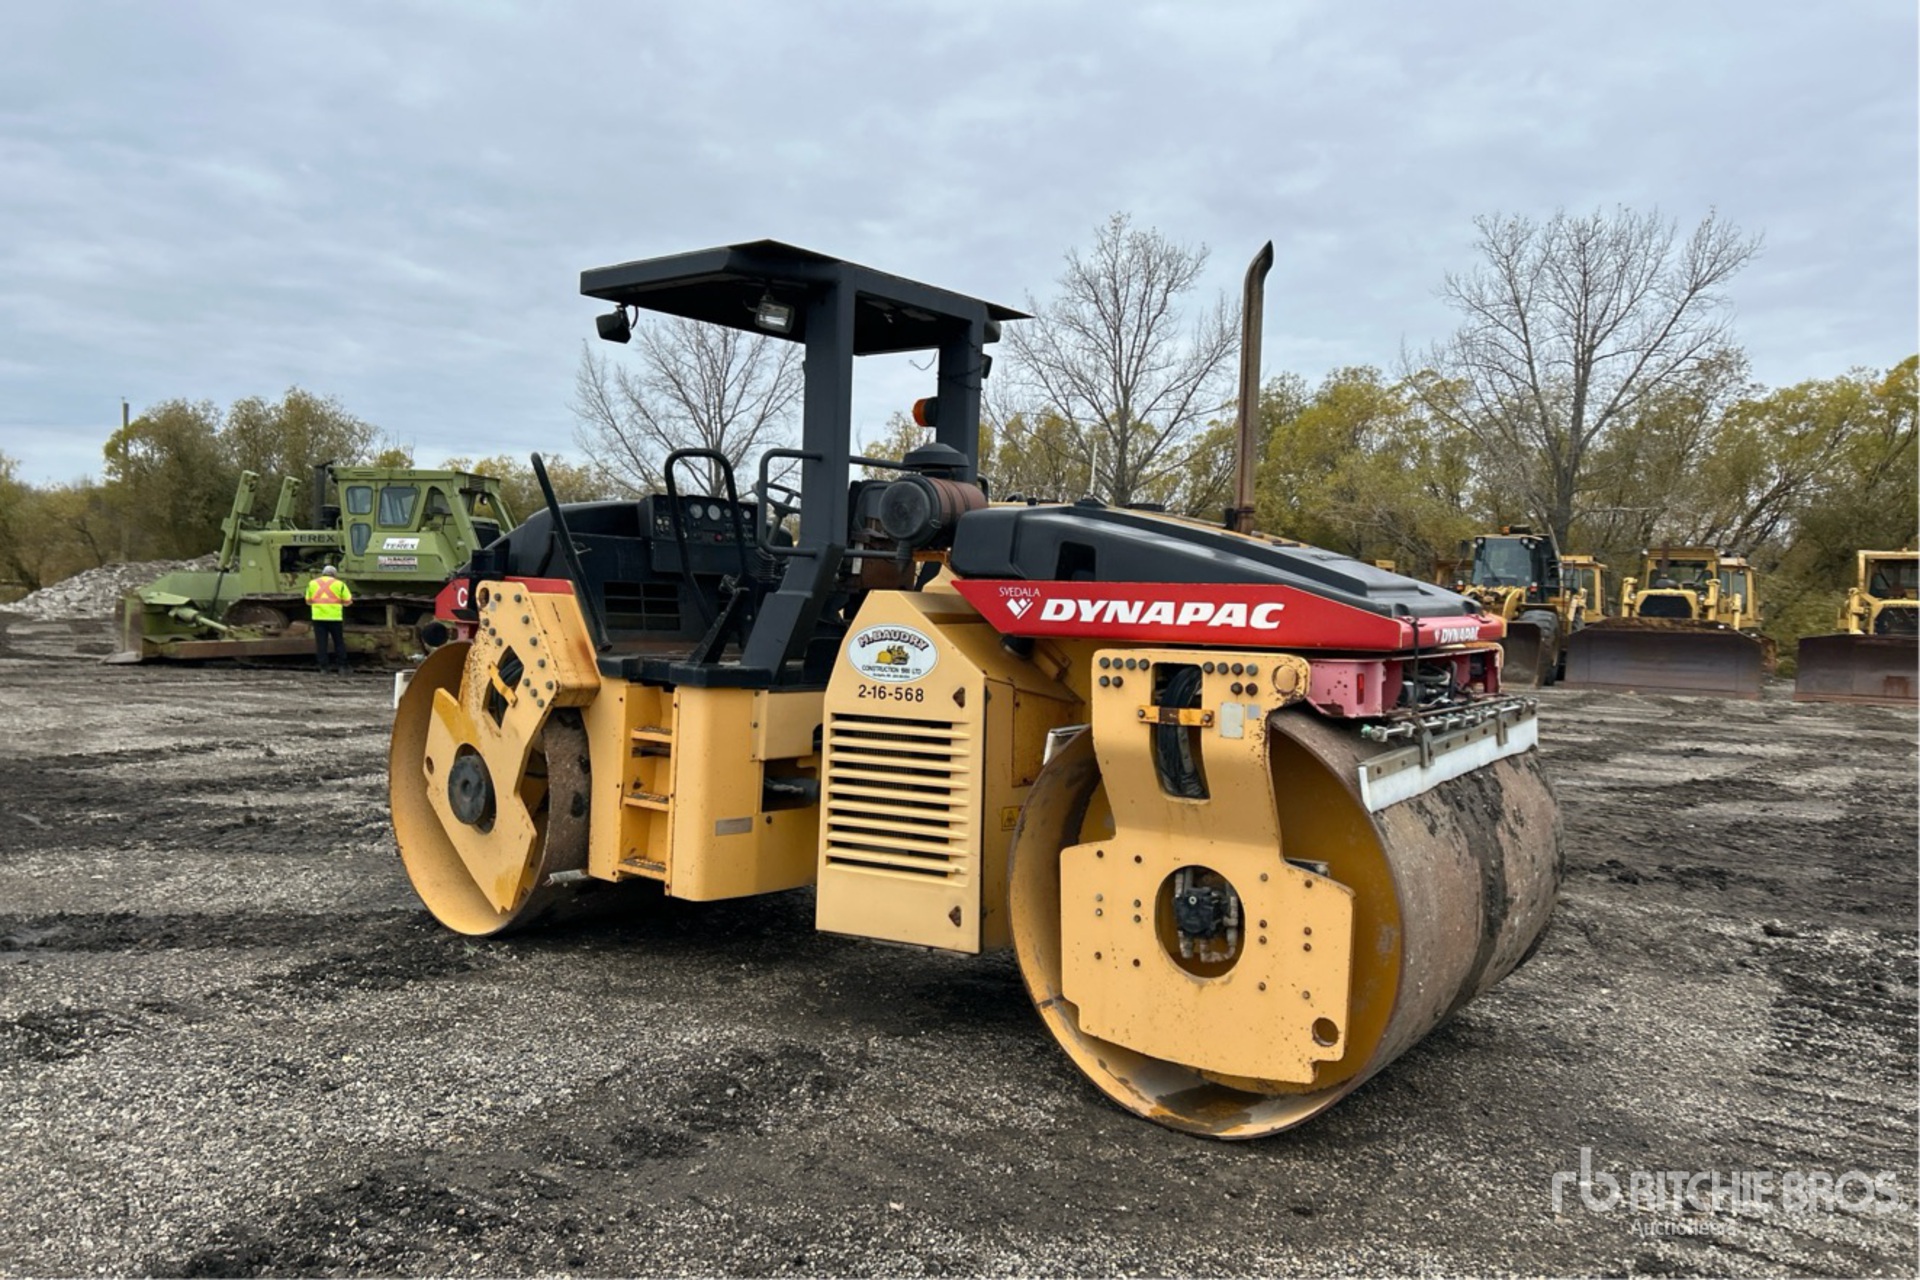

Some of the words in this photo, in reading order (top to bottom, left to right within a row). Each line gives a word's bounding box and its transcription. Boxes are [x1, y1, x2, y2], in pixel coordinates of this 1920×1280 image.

[292, 533, 335, 543] TEREX
[385, 542, 416, 550] TEREX
[999, 586, 1041, 598] SVEDALA
[1040, 599, 1285, 630] DYNAPAC
[1440, 626, 1480, 644] DYNAPAC
[861, 665, 899, 673] CONSTRUCTION
[912, 667, 922, 675] LTD
[858, 684, 924, 702] 2-16-568
